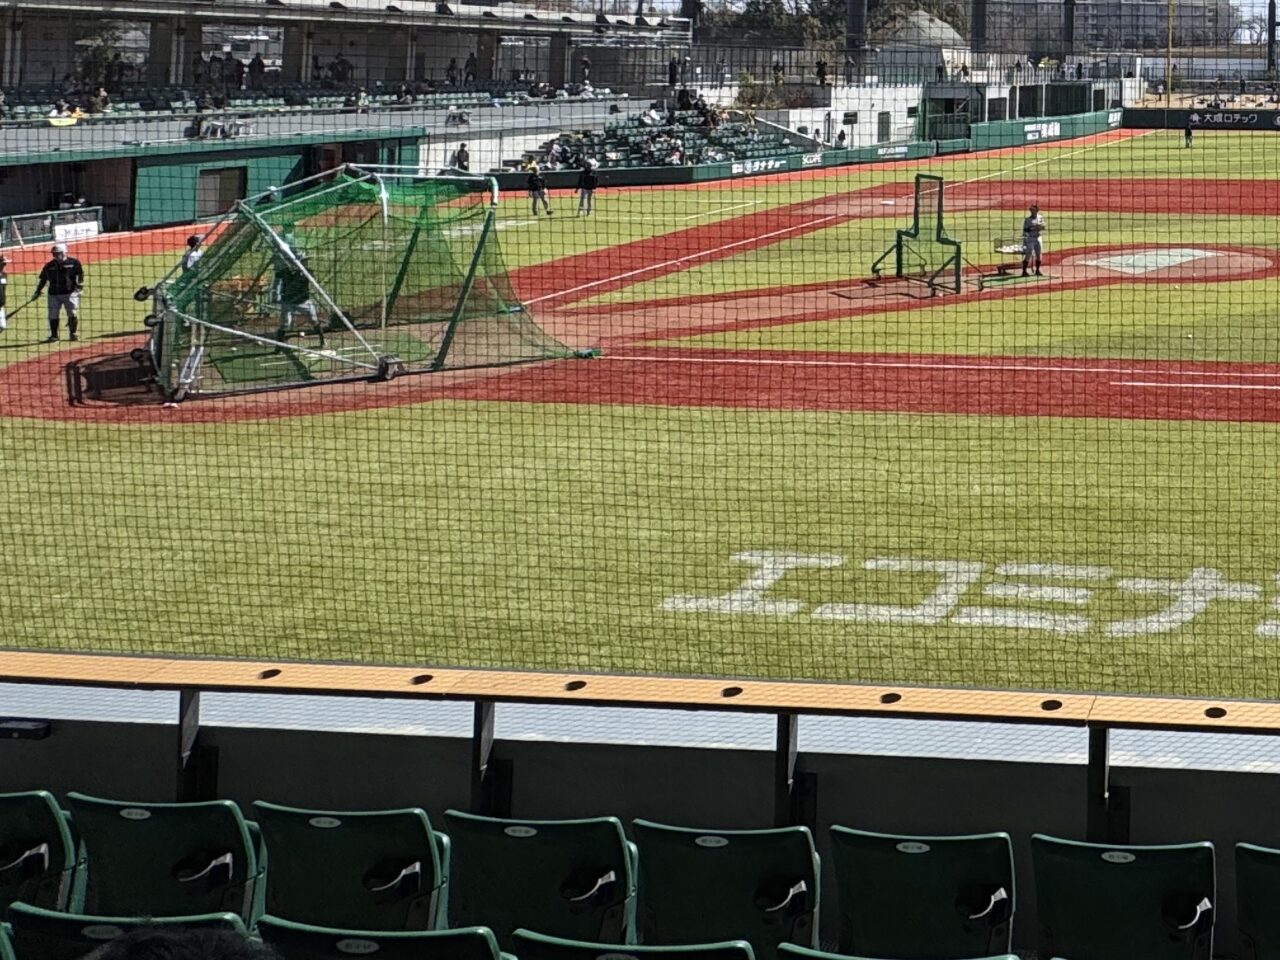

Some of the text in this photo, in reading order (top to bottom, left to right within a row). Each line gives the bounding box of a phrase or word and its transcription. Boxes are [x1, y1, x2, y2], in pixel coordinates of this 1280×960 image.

[1203, 113, 1258, 124] 大成ロテック
